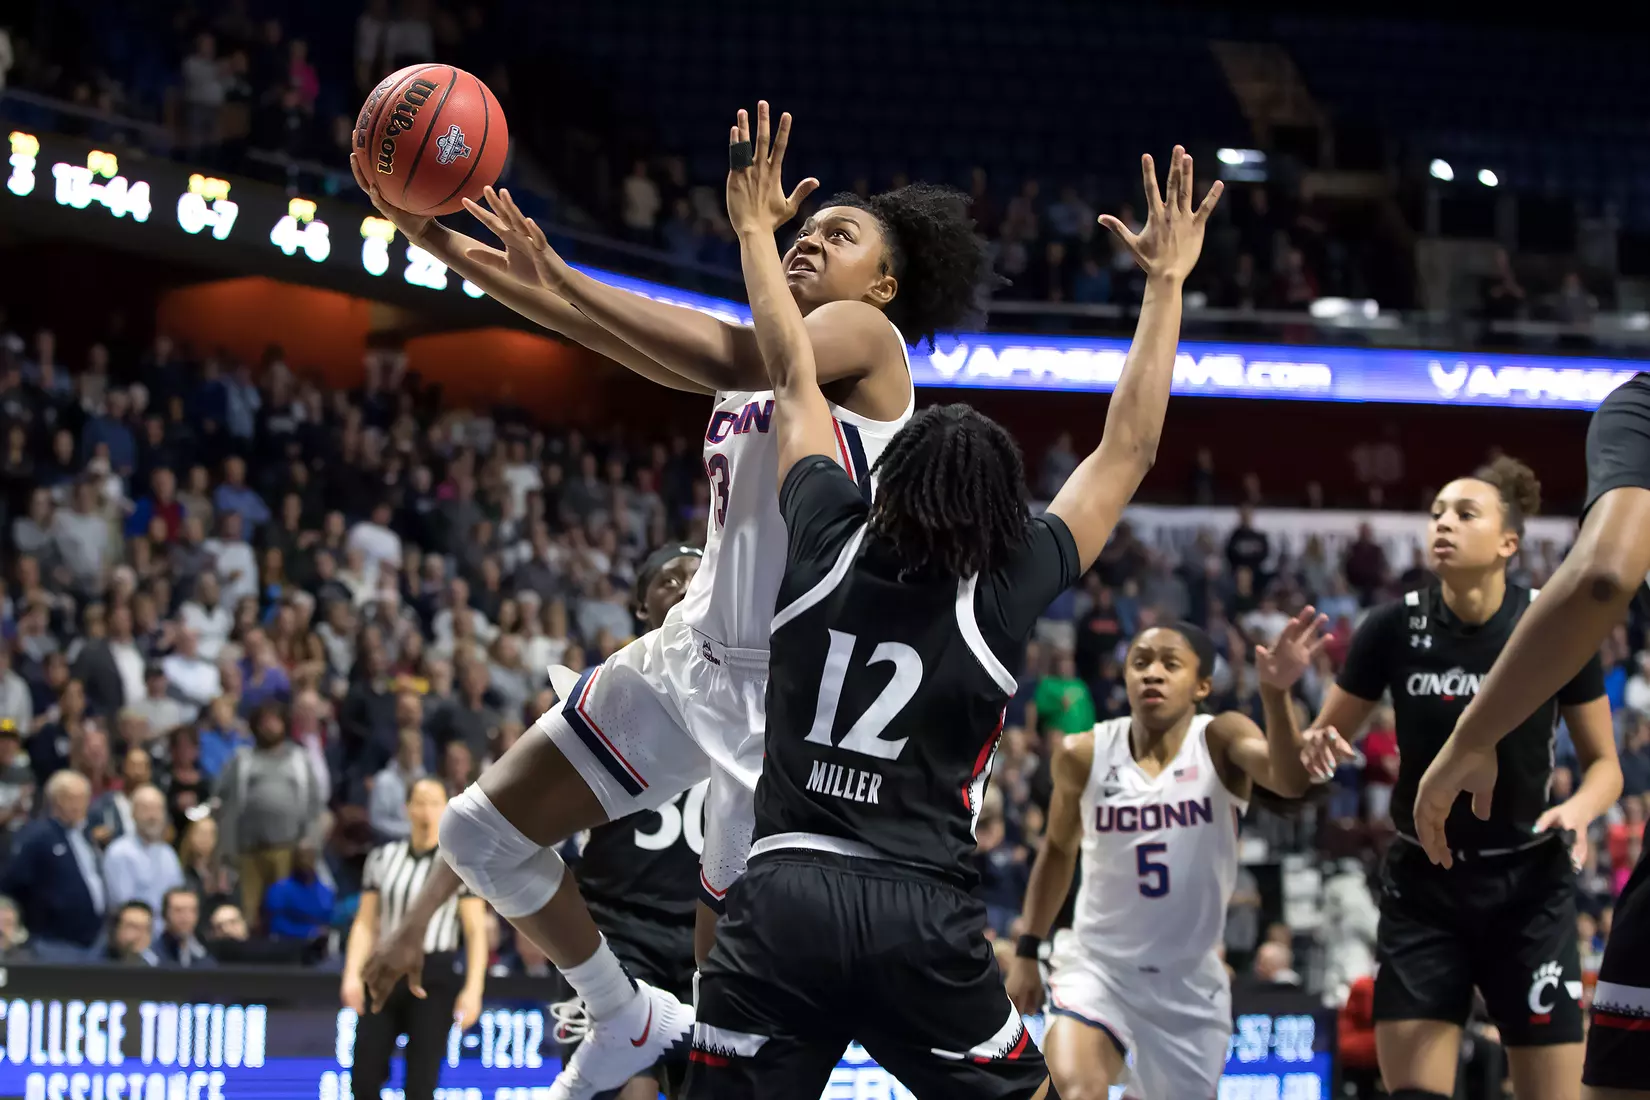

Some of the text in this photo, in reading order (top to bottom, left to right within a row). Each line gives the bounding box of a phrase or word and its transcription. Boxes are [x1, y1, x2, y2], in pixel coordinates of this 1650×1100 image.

[376, 78, 439, 175] Wilson
[804, 628, 924, 760] 12
[806, 760, 882, 804] MILLER
[1095, 797, 1213, 832] UCONN
[1136, 843, 1170, 900] 5
[0, 998, 127, 1066] OLLEGE
